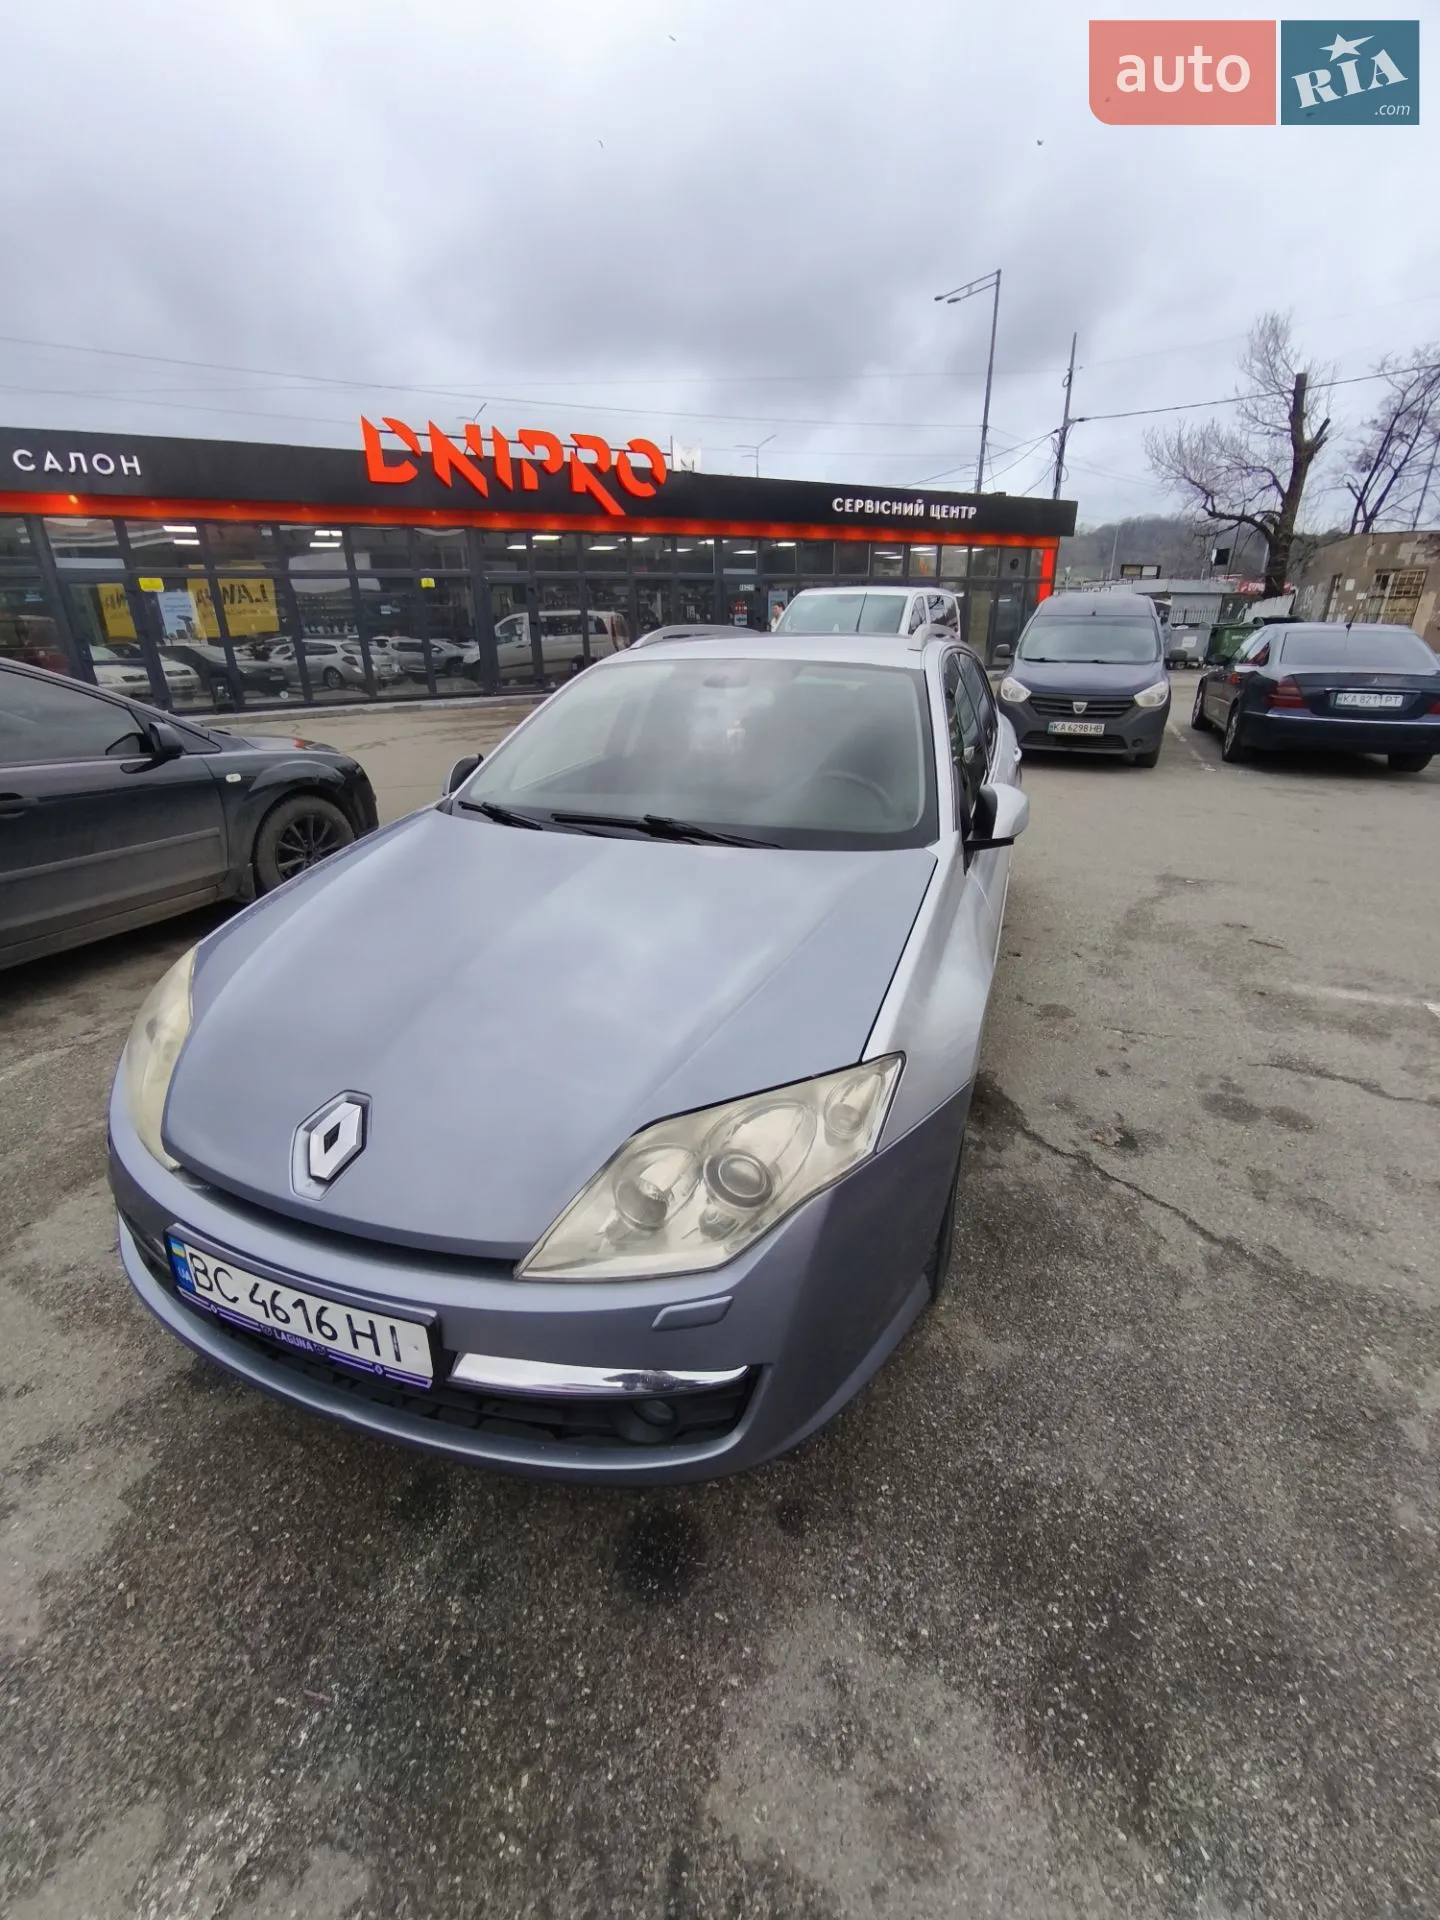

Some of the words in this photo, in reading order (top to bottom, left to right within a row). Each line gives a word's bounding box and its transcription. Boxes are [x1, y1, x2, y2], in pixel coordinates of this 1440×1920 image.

[12, 448, 142, 476] САЛОН
[361, 415, 667, 516] DNIPRO
[832, 498, 925, 517] СЕРВІСНИЙ
[930, 504, 977, 520] ЦЕНТР
[273, 1328, 314, 1352] LAGUNA
